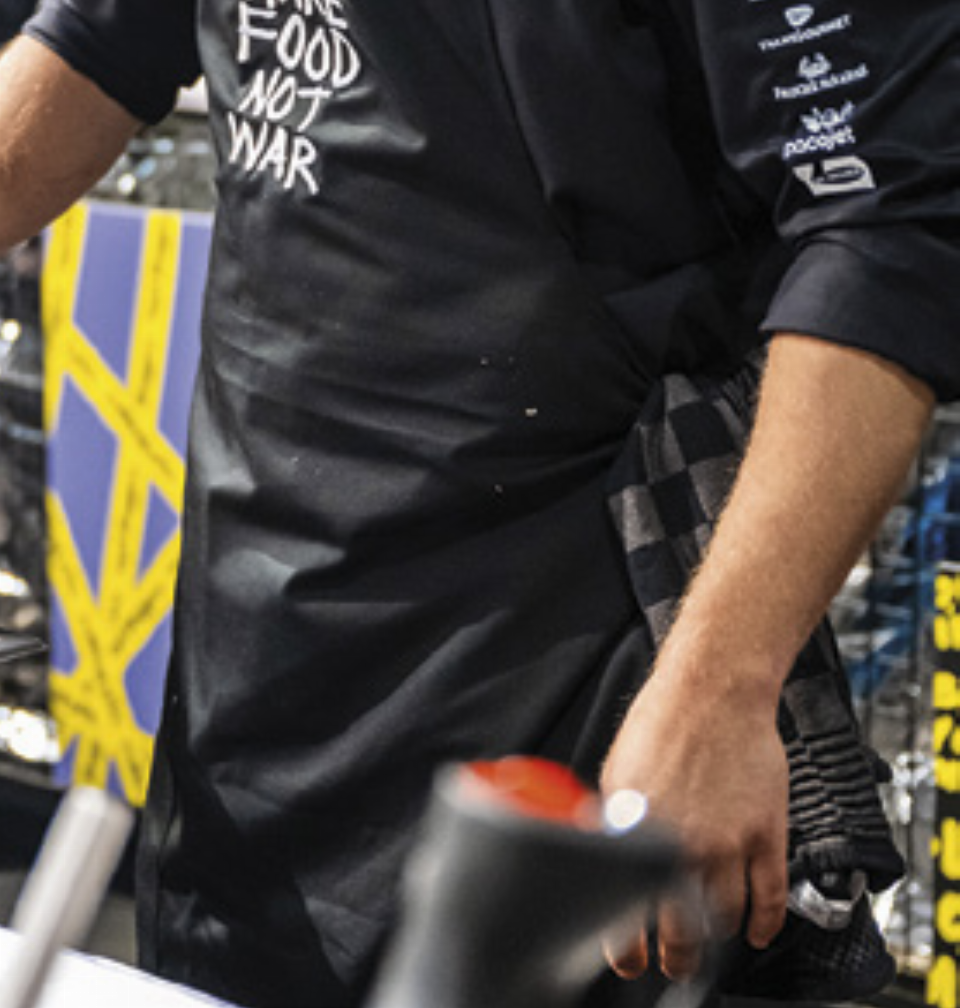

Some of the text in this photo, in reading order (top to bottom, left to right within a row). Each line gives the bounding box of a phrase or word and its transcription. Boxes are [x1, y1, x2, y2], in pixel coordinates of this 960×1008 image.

[236, 0, 361, 89] FOOD
[238, 66, 333, 133] NOT
[227, 110, 320, 196] WAR
